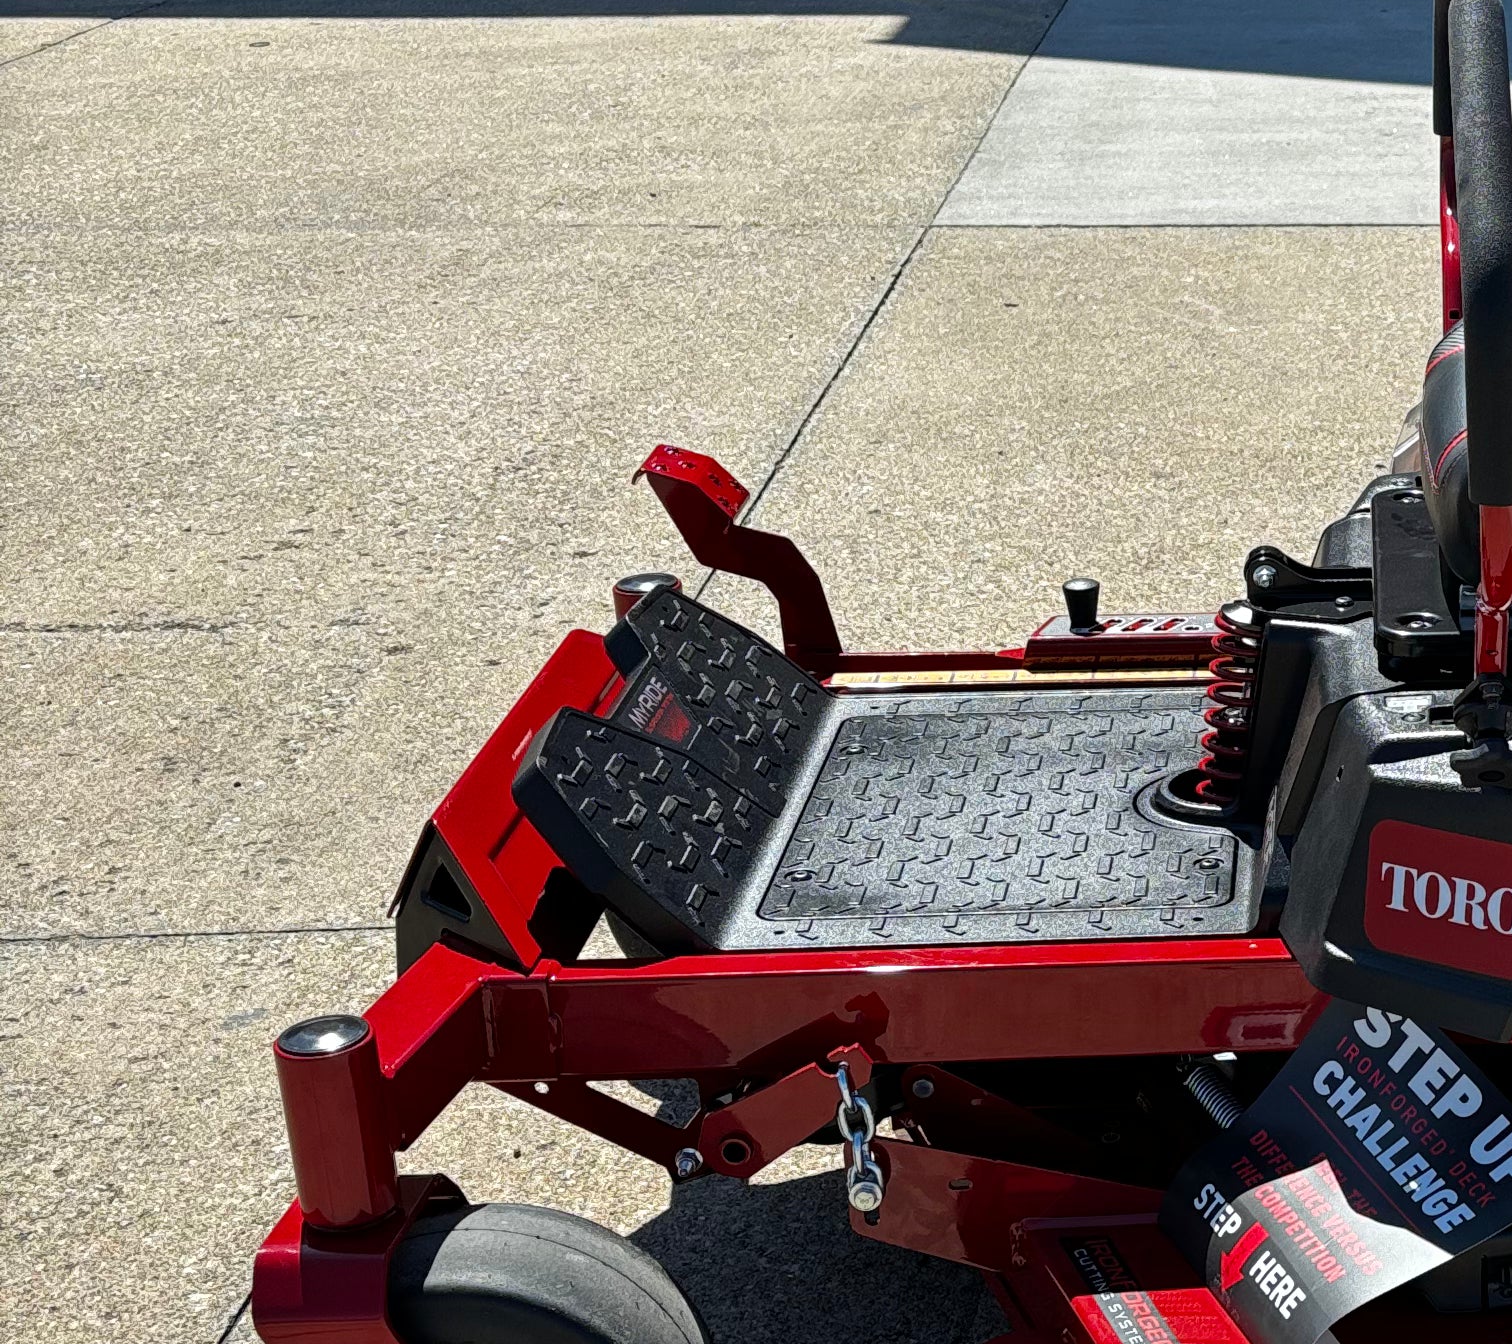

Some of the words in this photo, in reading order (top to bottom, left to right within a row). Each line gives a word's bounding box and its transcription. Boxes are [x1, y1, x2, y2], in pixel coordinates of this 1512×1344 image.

[1354, 1006, 1483, 1120] STEP
[1313, 1060, 1477, 1234] CHALLENGE
[1449, 1161, 1496, 1208] DECK
[1073, 1248, 1114, 1302] CUTTING
[1193, 1183, 1242, 1238] STEP
[1249, 1250, 1306, 1320] HERE
[1231, 1155, 1264, 1188] THE
[1254, 1183, 1347, 1284] COMPETITION
[1322, 1213, 1383, 1276] VERSUS
